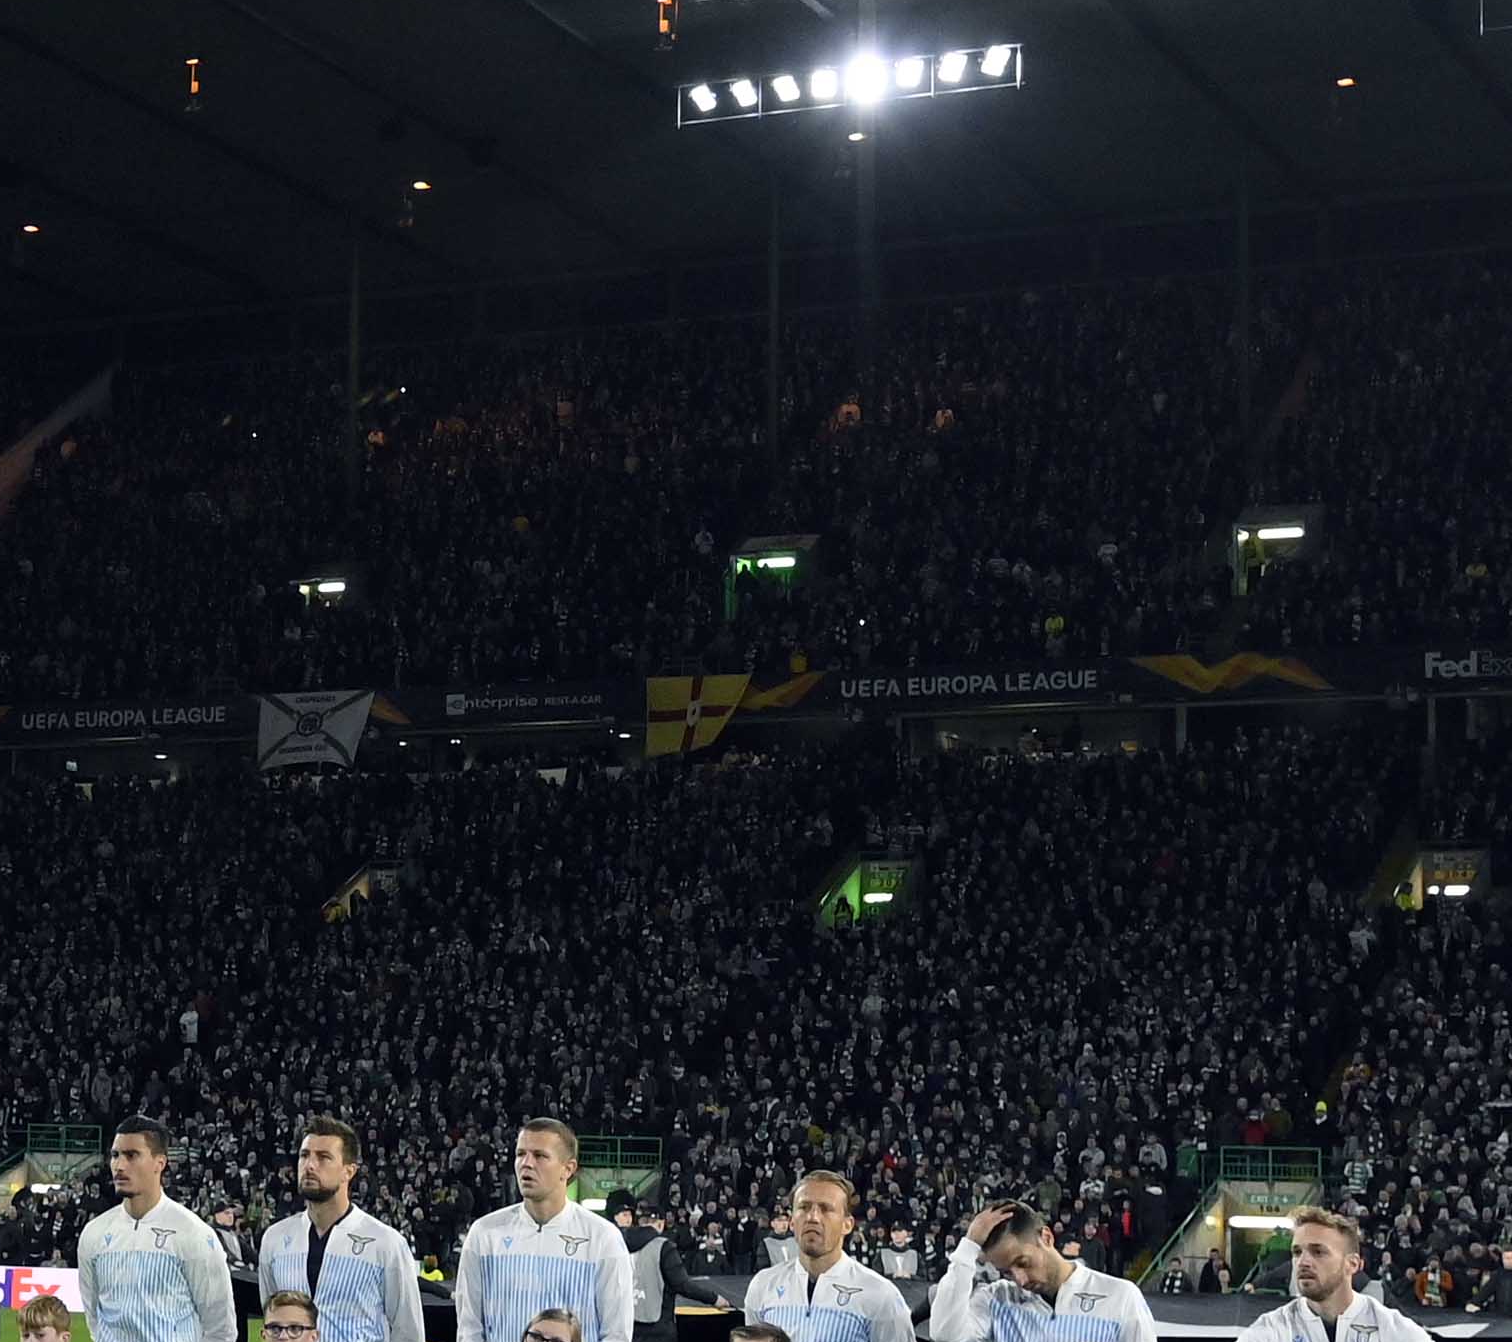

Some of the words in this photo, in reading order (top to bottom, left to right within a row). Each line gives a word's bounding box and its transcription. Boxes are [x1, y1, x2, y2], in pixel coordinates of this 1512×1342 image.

[839, 676, 902, 701] UEFA
[908, 673, 997, 698] EUROPA
[1002, 669, 1097, 693] LEAGUE
[21, 712, 69, 731] UEFA
[74, 709, 146, 728] EUROPA
[151, 706, 226, 726] LEAGUE
